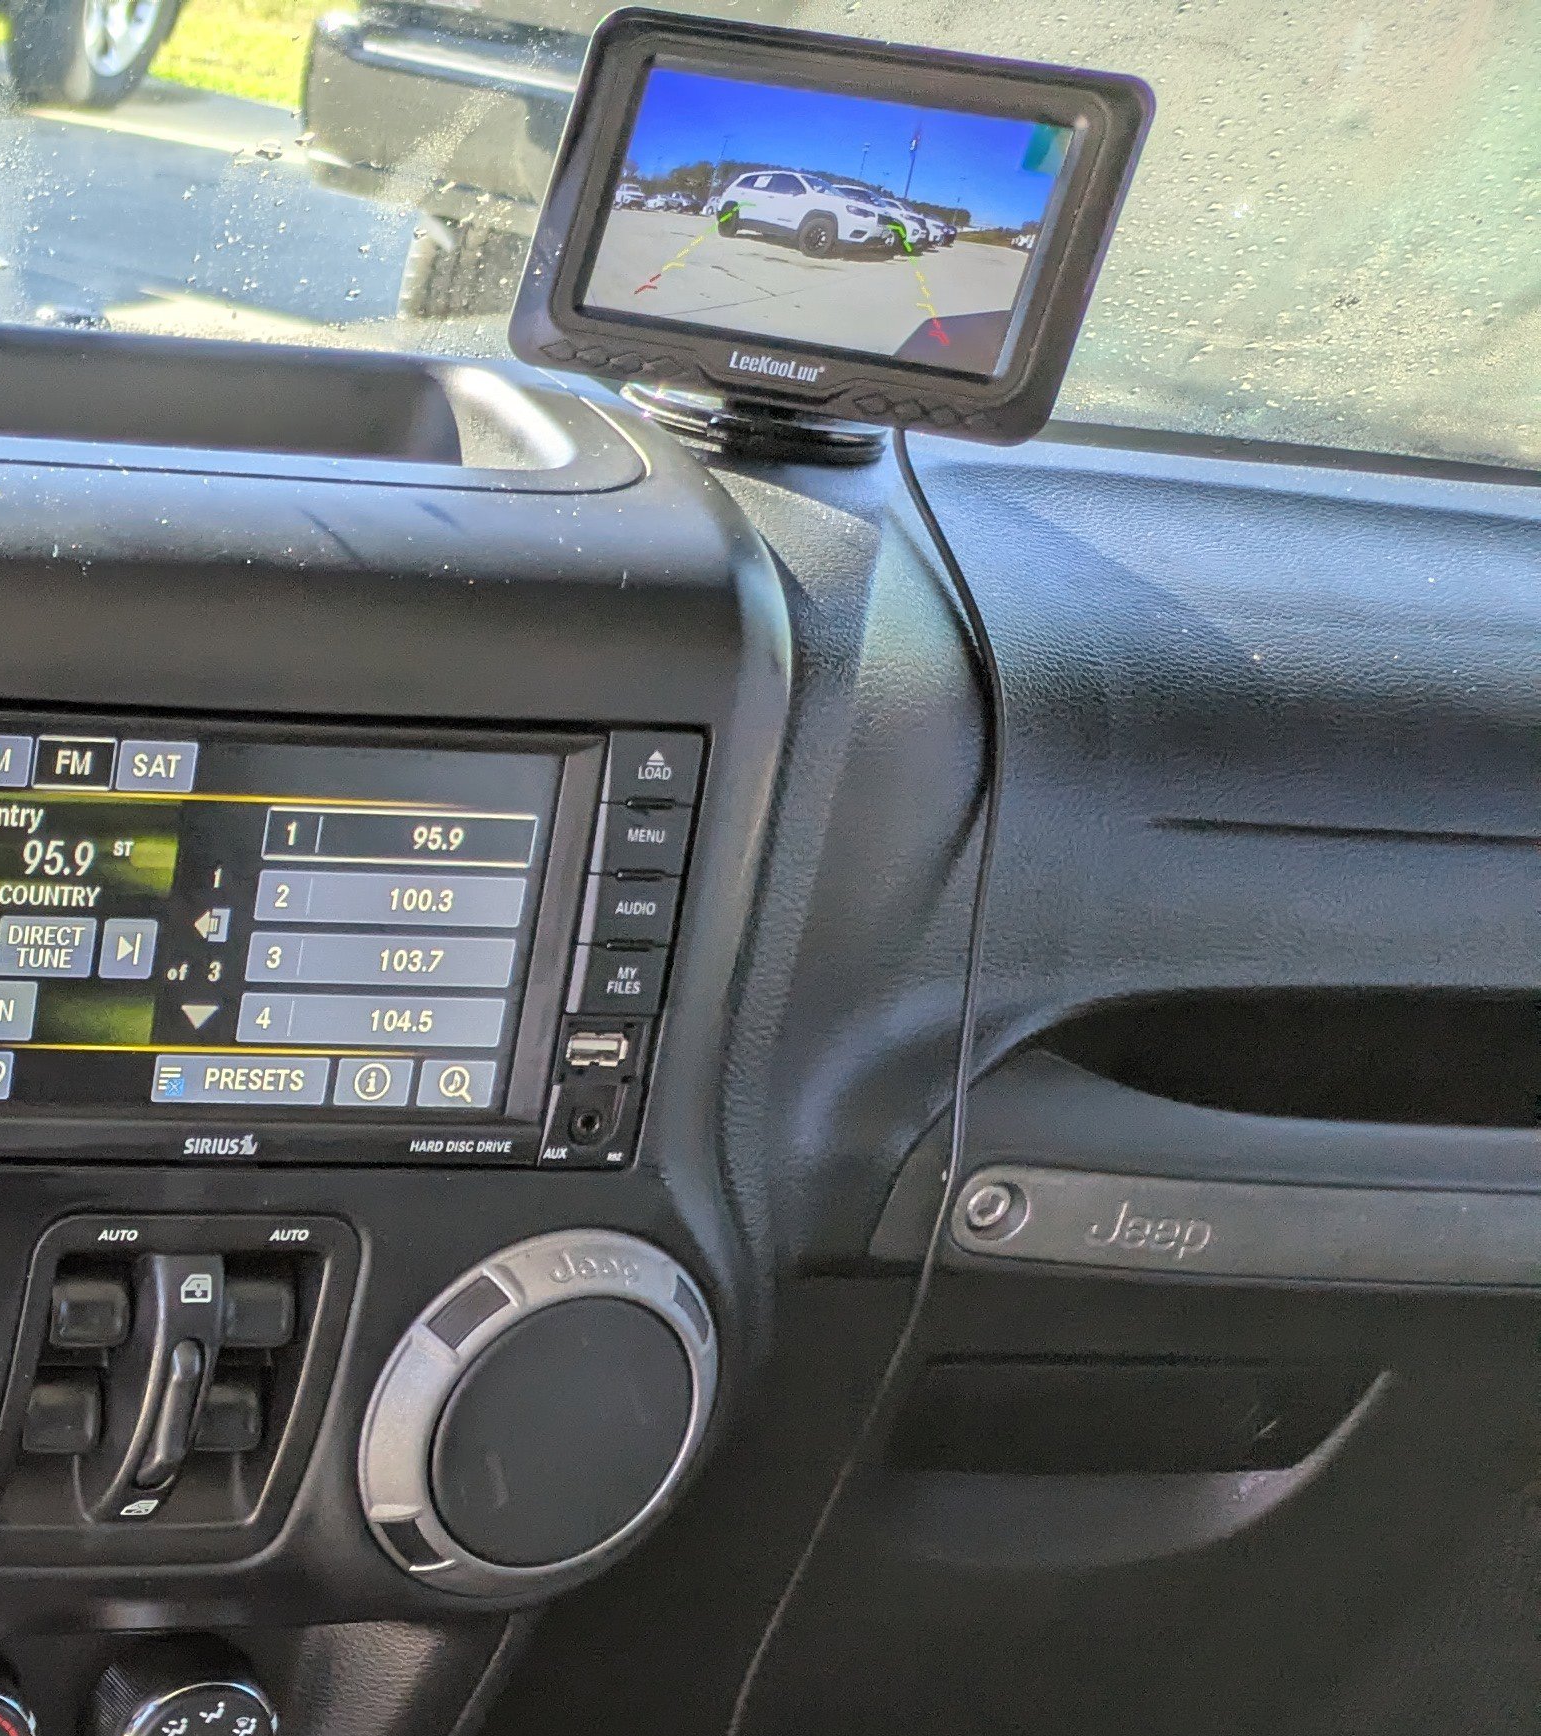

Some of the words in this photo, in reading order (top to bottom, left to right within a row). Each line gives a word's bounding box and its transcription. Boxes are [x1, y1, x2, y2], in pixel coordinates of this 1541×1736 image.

[55, 750, 92, 775] FM
[133, 754, 181, 779] SAT
[638, 766, 672, 780] LOAD
[286, 821, 297, 846] 1
[413, 826, 464, 851] 95.9
[627, 828, 665, 844] MENU
[23, 839, 95, 876] 95.9
[113, 841, 135, 857] ST
[213, 868, 222, 888] 1
[275, 884, 290, 908] 2
[389, 888, 454, 912] 100.3
[615, 901, 657, 916] AUDIO
[8, 925, 85, 948] DIRECT
[16, 948, 74, 970] TUNE
[266, 946, 282, 969] 3
[380, 949, 445, 973] 103.7
[167, 963, 187, 981] of
[208, 962, 222, 981] 3
[617, 967, 638, 981] MY
[606, 980, 641, 995] FILES
[255, 1007, 271, 1030] 4
[371, 1010, 433, 1032] 104.5
[204, 1068, 305, 1092] PRESETS
[183, 1139, 240, 1155] SIRIUS
[410, 1140, 444, 1153] HARD
[446, 1141, 475, 1153] DISC
[476, 1140, 512, 1153] DRIVE
[543, 1147, 568, 1159] AUX
[97, 1229, 139, 1242] AUTO
[269, 1229, 310, 1242] AUTO
[1085, 1203, 1213, 1259] Jeep
